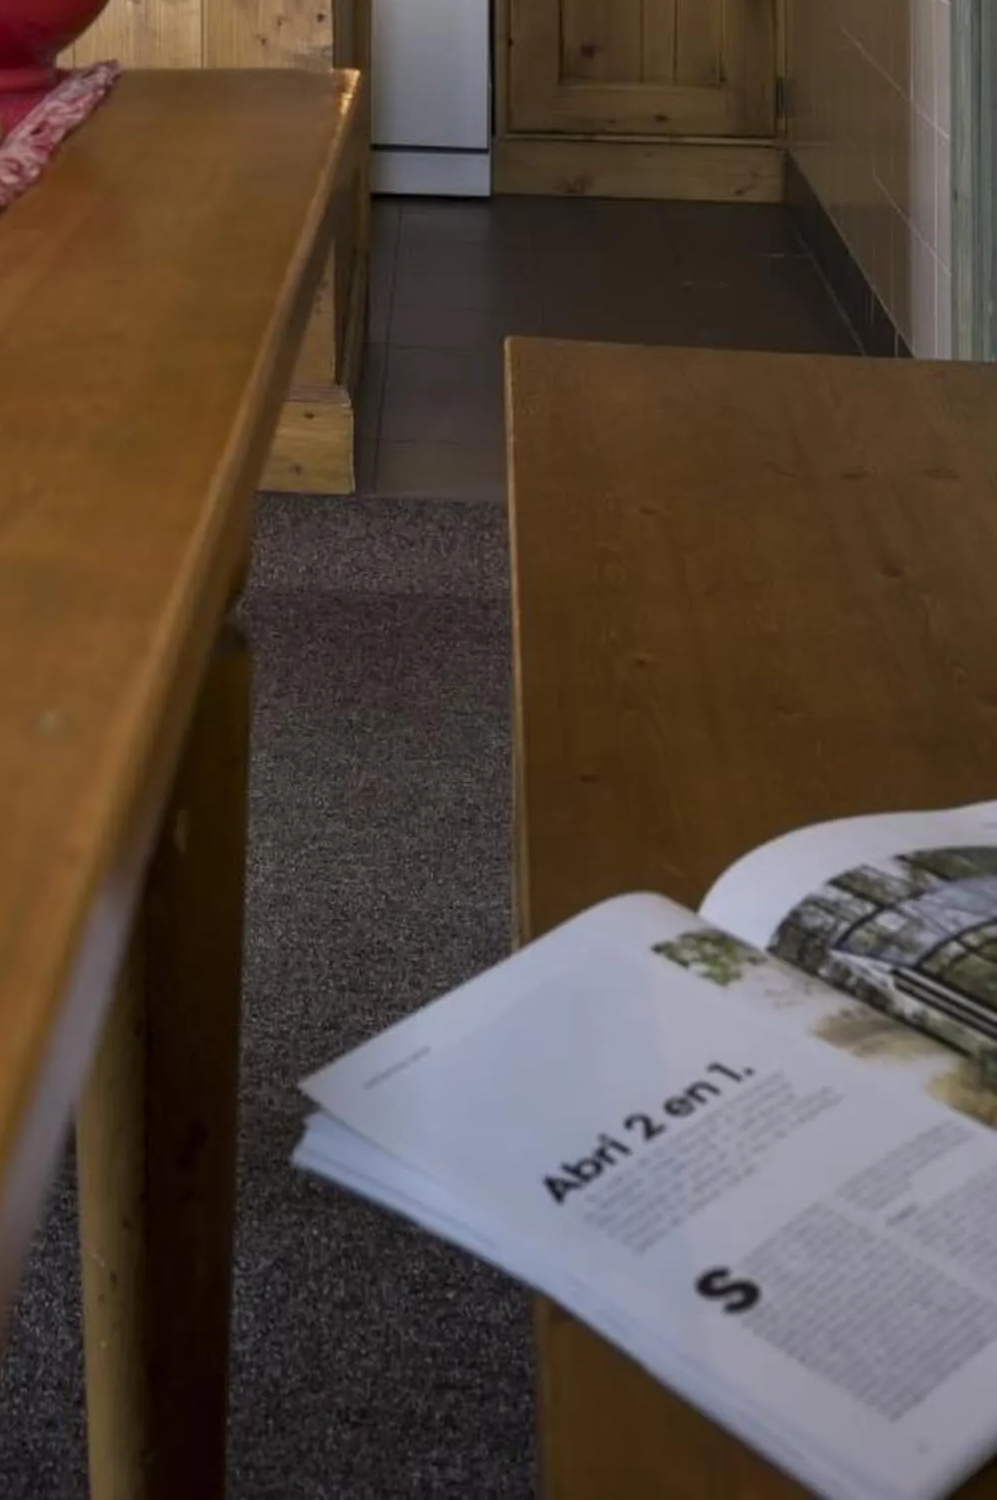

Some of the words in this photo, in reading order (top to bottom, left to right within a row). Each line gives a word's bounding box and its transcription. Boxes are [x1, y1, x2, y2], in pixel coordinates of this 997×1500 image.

[543, 1132, 633, 1205] Abri
[623, 1112, 667, 1142] 2
[662, 1080, 721, 1119] en
[705, 1061, 756, 1084] 1.
[695, 1266, 762, 1316] S
